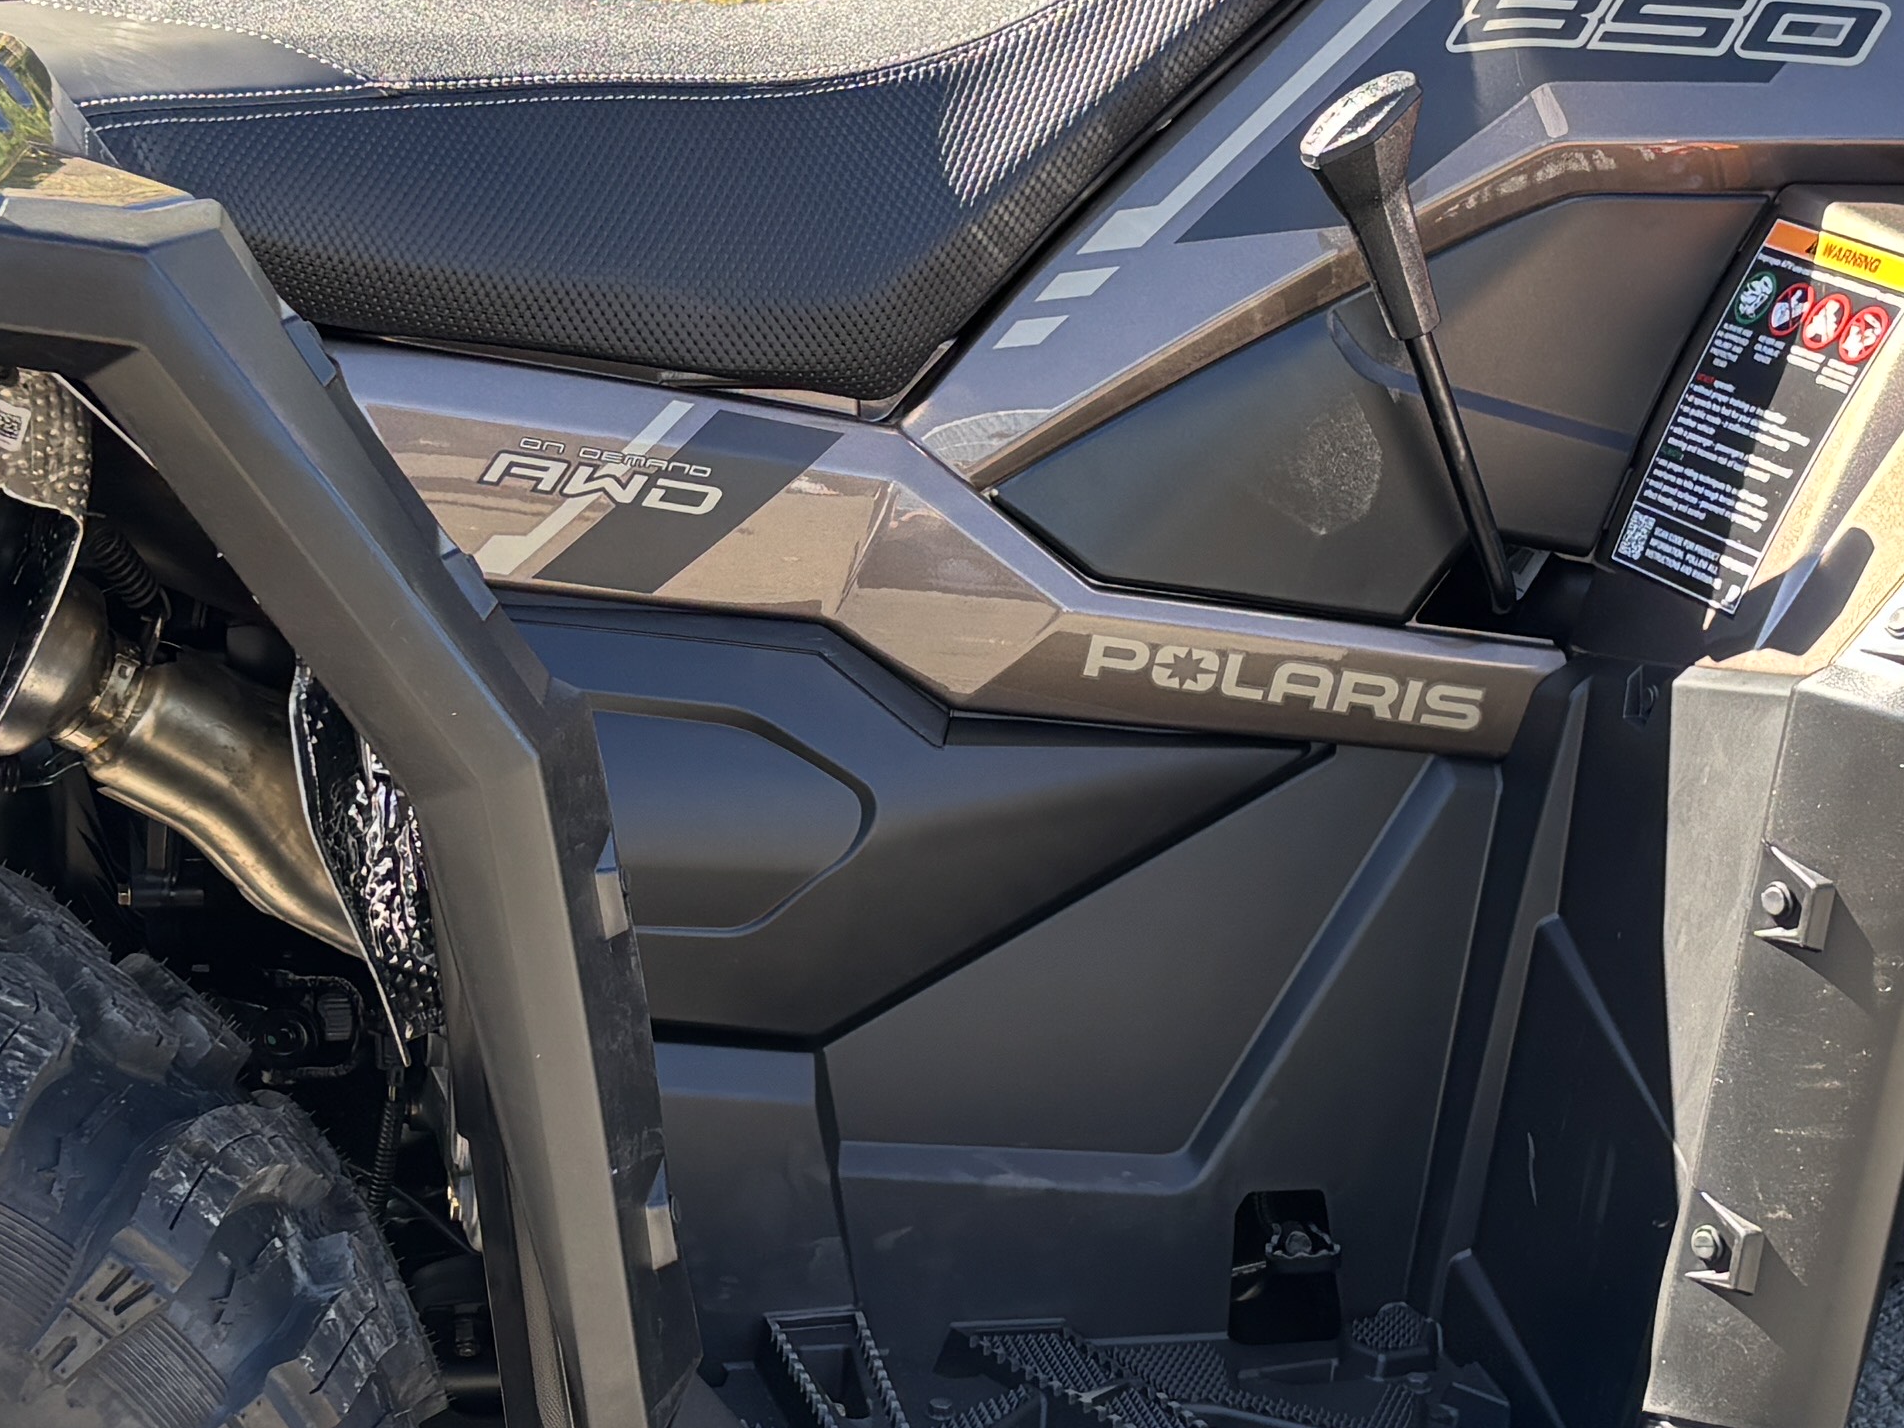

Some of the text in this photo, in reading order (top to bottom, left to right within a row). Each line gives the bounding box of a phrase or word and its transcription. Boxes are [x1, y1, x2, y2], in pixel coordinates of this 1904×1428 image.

[478, 450, 723, 515] AWD
[519, 437, 713, 477] ON DEMAND
[1083, 633, 1486, 731] POLARIS
